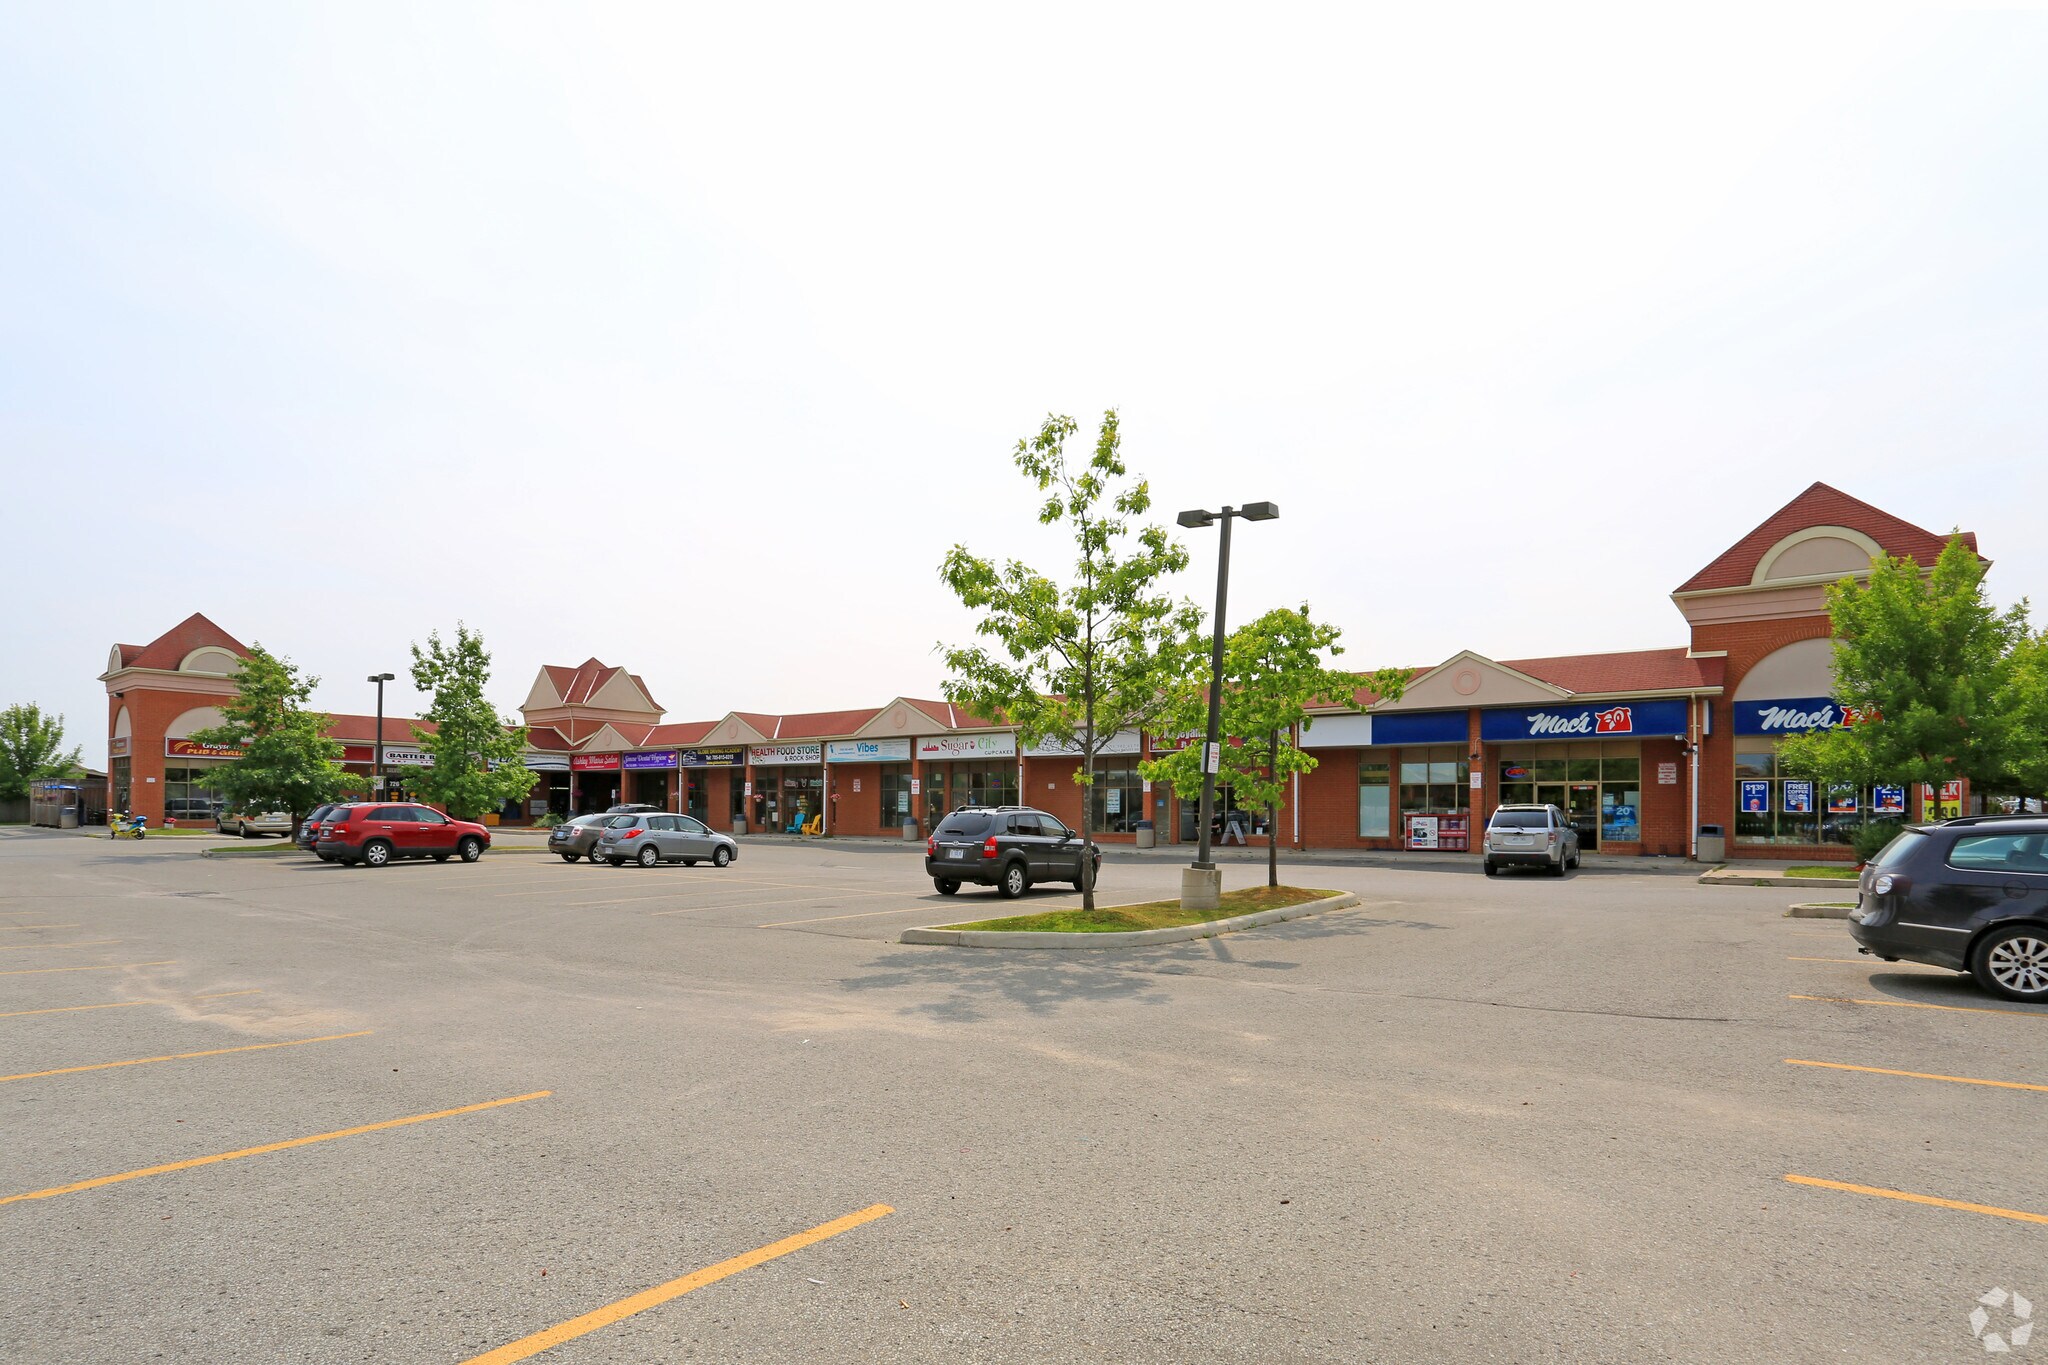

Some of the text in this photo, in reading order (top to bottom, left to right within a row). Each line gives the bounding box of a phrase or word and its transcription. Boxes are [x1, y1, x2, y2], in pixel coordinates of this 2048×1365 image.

[1527, 712, 1592, 735] Mac's
[1758, 705, 1836, 730] Mac's
[751, 745, 820, 756] HEALTH FOOD STORE
[856, 742, 879, 753] Vibes
[940, 735, 998, 756] Sugar City
